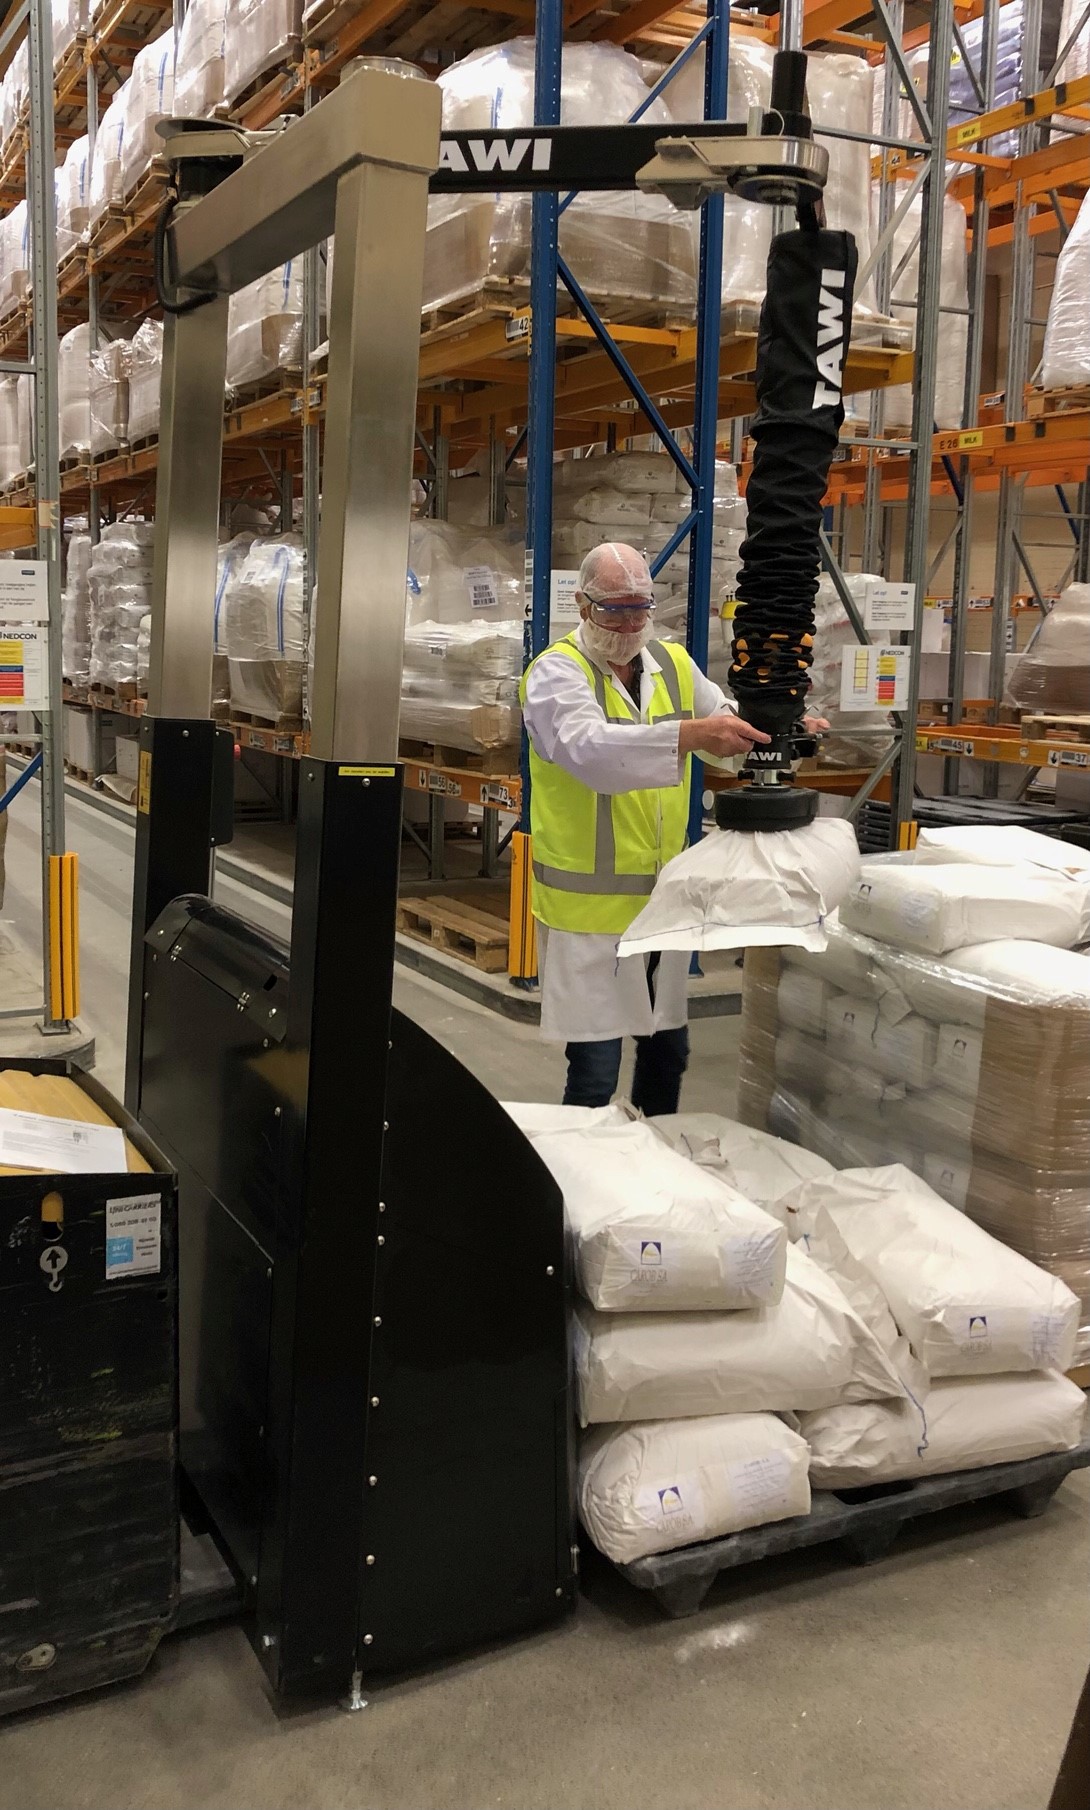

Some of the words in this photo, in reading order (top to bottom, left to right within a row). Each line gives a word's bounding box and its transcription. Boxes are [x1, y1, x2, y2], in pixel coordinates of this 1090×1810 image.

[439, 138, 552, 171] AWI
[812, 268, 845, 409] TAWI
[964, 435, 977, 444] MILK
[747, 751, 782, 761] AWI
[1075, 753, 1087, 763] 37
[499, 787, 508, 800] 73
